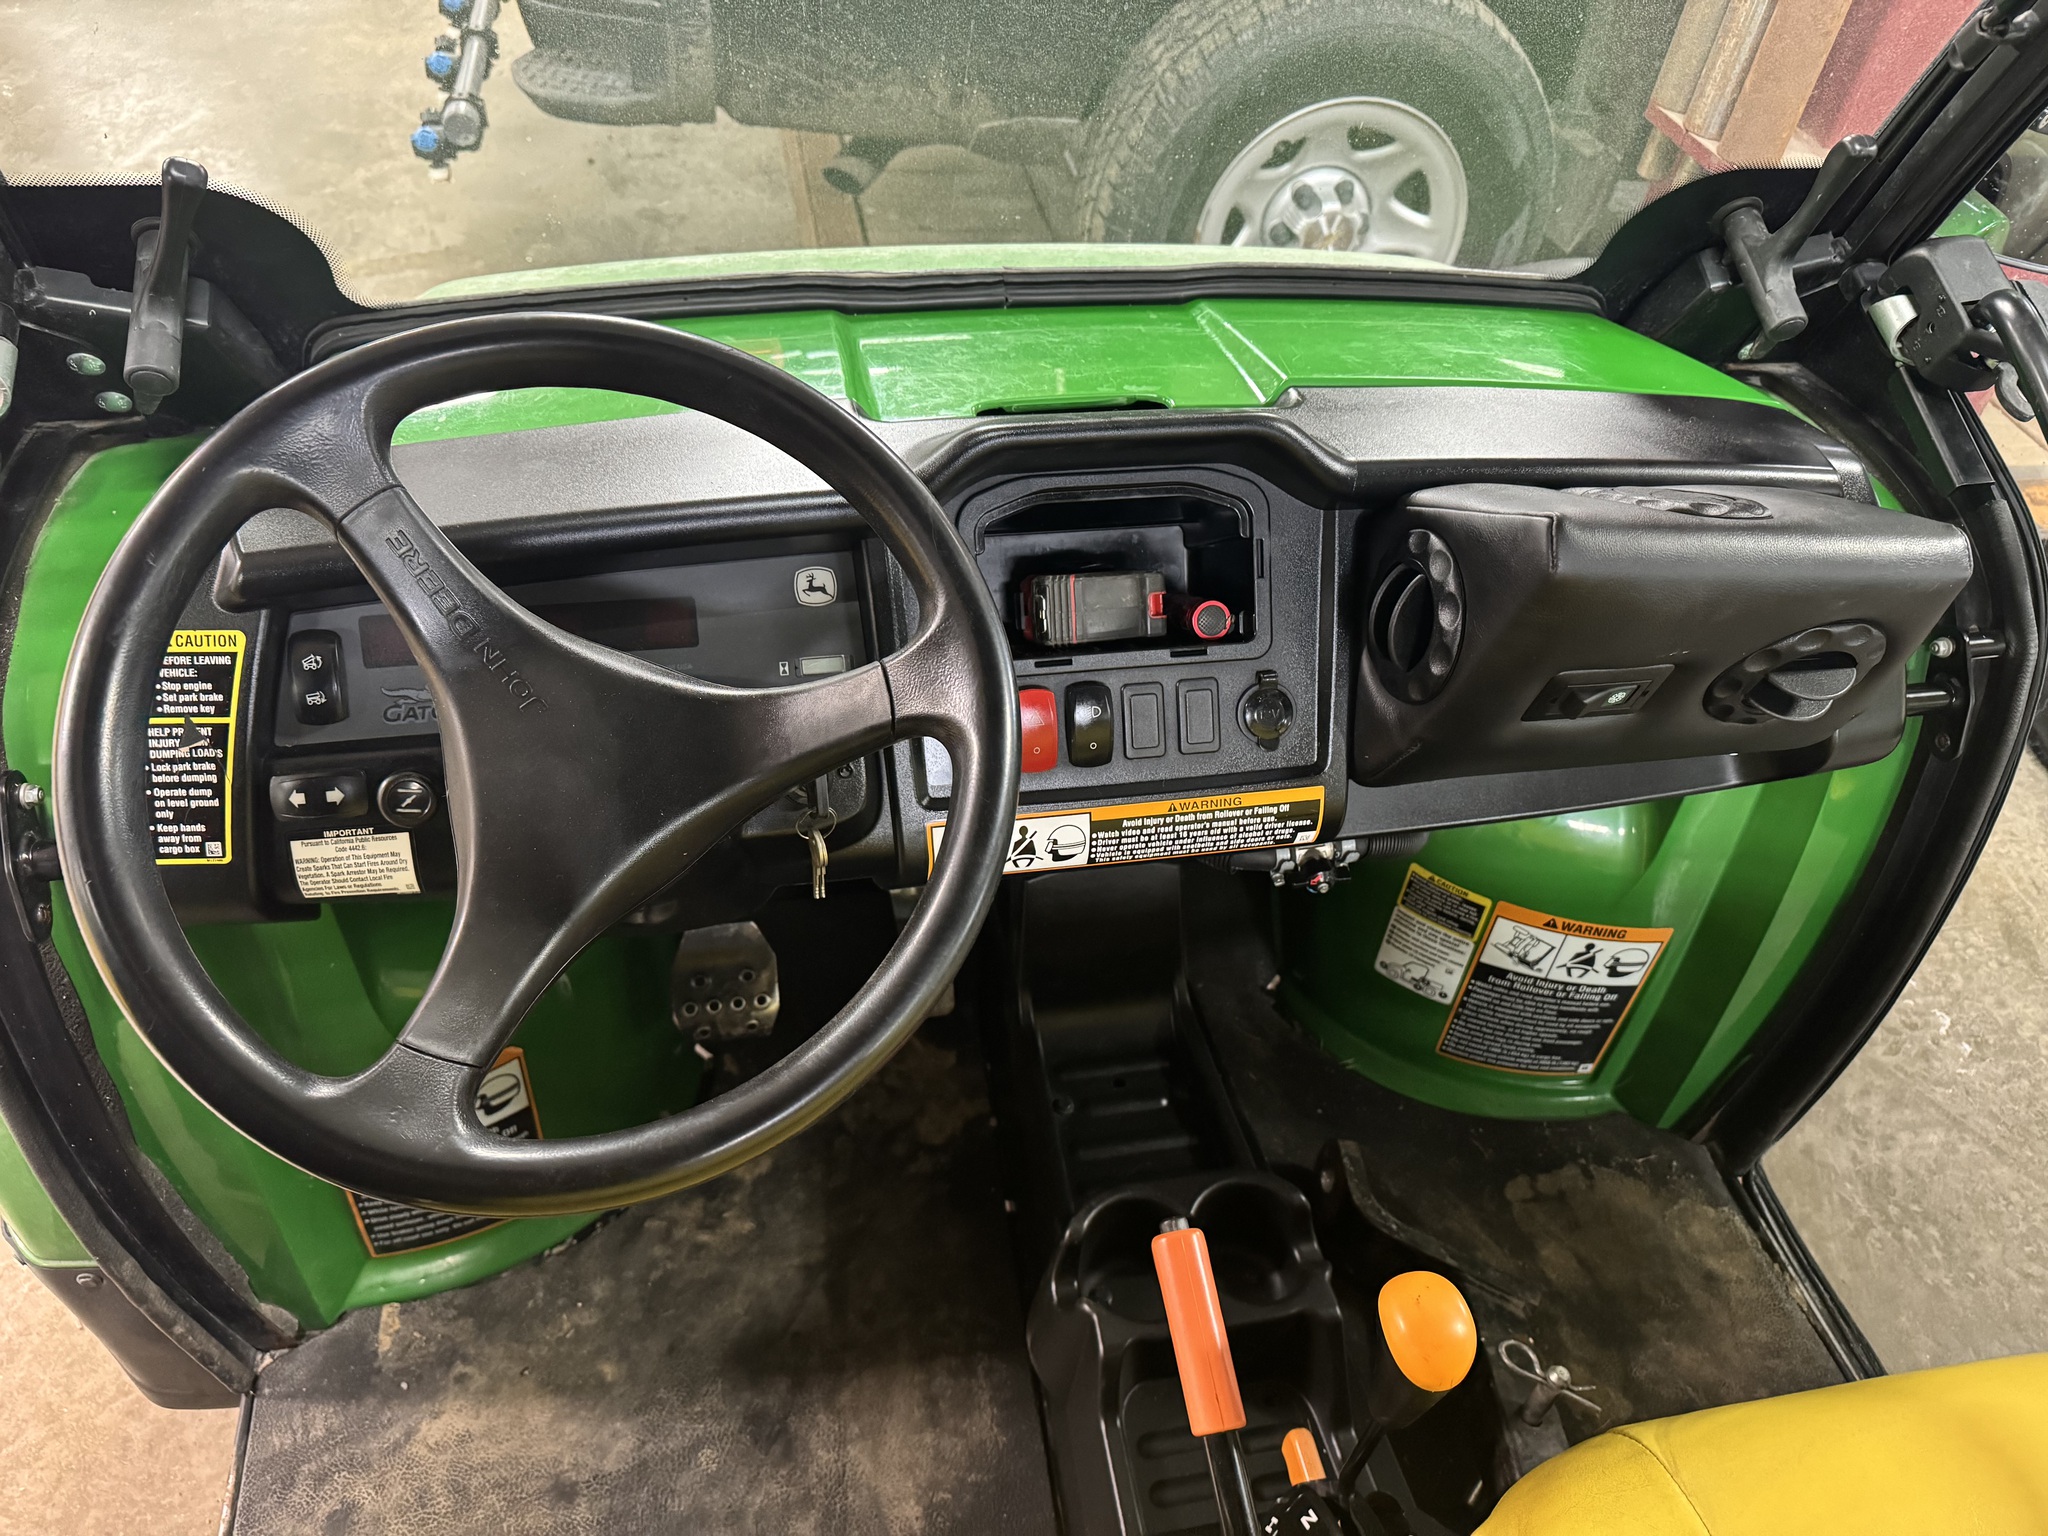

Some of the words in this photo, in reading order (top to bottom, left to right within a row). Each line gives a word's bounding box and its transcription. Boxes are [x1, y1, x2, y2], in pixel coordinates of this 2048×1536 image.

[385, 529, 480, 641] DEERE
[176, 635, 236, 646] CAUTION
[163, 656, 192, 665] EFORE
[194, 656, 231, 665] LEAVING
[162, 681, 181, 692] Stop
[183, 681, 212, 691] engine
[162, 693, 177, 701] Set
[179, 693, 198, 703] park
[200, 693, 223, 701] brake
[163, 704, 198, 714] Remove
[200, 704, 215, 714] key
[148, 728, 170, 736] HELP
[149, 739, 180, 748] INJURY
[150, 750, 190, 758] DUMPING
[151, 763, 171, 771] Lock
[172, 762, 191, 772] park
[192, 762, 216, 770] brake
[152, 774, 179, 782] before
[182, 773, 218, 783] dumping
[153, 788, 187, 798] Operate
[189, 788, 212, 797] dump
[167, 799, 188, 807] level
[190, 798, 219, 808] ground
[1179, 797, 1242, 811] WARNING
[156, 810, 174, 820] only
[1122, 818, 1142, 827] Avoid
[1144, 816, 1164, 827] Injury
[1175, 813, 1195, 822] Death
[1197, 812, 1213, 820] from
[1214, 810, 1244, 818] Rollover
[1254, 806, 1277, 815] Falling
[1279, 804, 1290, 812] Off
[157, 824, 178, 833] Keep
[180, 823, 206, 832] hands
[323, 828, 374, 837] IMPORTANT
[1098, 830, 1119, 839] Watch
[1121, 828, 1140, 836] video
[1142, 827, 1155, 835] and
[1157, 825, 1173, 833] read
[1175, 821, 1209, 832] operator's
[1239, 817, 1260, 825] before
[1098, 838, 1119, 846] Driver
[1121, 836, 1138, 844] must
[1160, 832, 1177, 840] least
[1189, 830, 1208, 838] years
[1223, 826, 1237, 834] with
[1246, 822, 1262, 831] valid
[1264, 821, 1284, 830] driver
[1287, 819, 1313, 827] license.
[158, 836, 180, 844] away
[182, 834, 202, 842] from
[1120, 842, 1146, 851] operate
[1148, 839, 1173, 847] vehicle
[1175, 837, 1194, 845] under
[1196, 834, 1228, 843] influence
[1239, 830, 1264, 838] alcohol
[1274, 828, 1295, 836] drugs.
[159, 846, 183, 854] cargo
[1133, 847, 1164, 855] equipped
[1182, 842, 1214, 850] seatbelts
[363, 852, 389, 860] Equipment
[1435, 878, 1469, 898] CAUTION
[1561, 921, 1627, 940] WARNING
[1487, 975, 1512, 987] from
[1512, 981, 1555, 996] Rollover
[1568, 992, 1602, 1001] Falling
[1603, 993, 1618, 1001] Off
[1506, 972, 1534, 984] Avoid
[1536, 979, 1564, 991] Injury
[1579, 985, 1607, 994] Death
